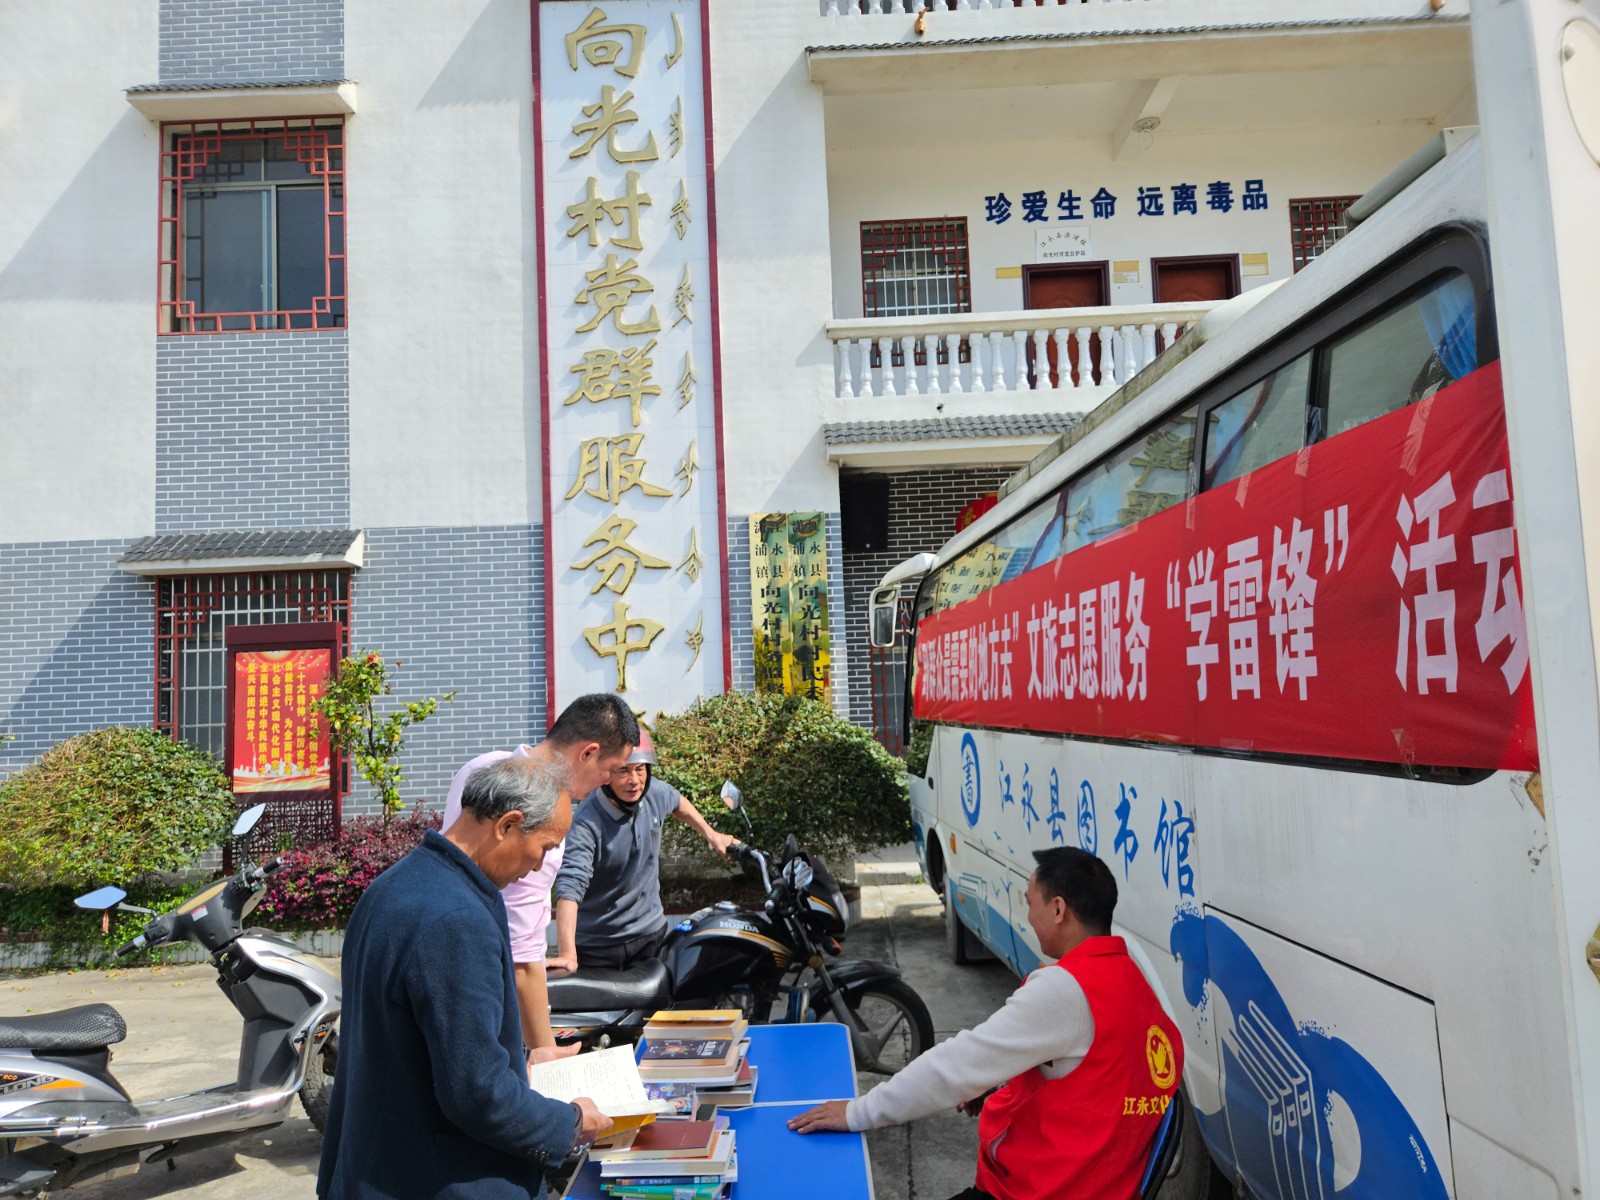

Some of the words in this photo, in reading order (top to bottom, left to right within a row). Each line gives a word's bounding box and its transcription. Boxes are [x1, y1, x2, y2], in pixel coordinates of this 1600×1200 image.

[984, 186, 1117, 225] 珍爱生命
[1136, 179, 1269, 217] 远离毒品
[564, 6, 673, 728] 向光村党群服务中
[1027, 570, 1150, 702] 文旅志愿服务
[1166, 504, 1349, 702] “学雷锋”
[1390, 468, 1529, 696] 活动
[271, 662, 281, 771] 社会主义现代化国家
[998, 759, 1196, 900] 江永县图书馆
[719, 920, 760, 934] HONDA
